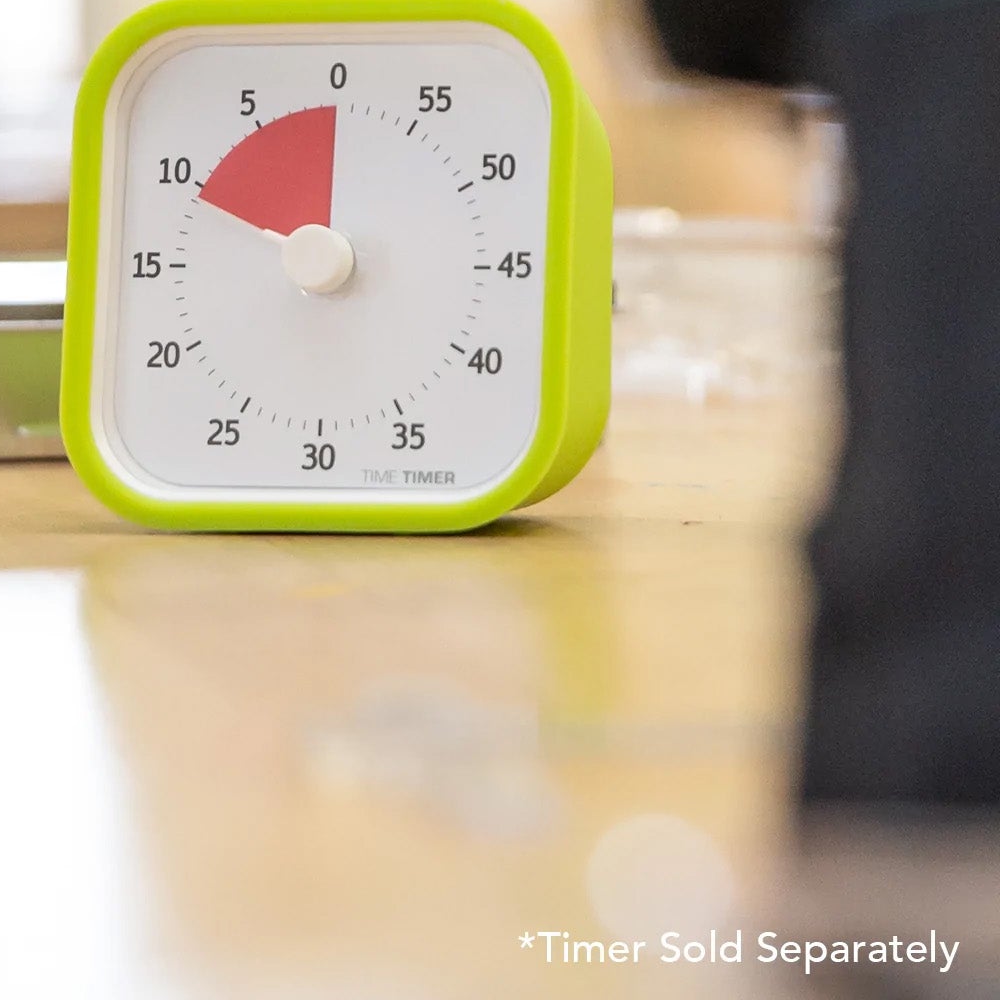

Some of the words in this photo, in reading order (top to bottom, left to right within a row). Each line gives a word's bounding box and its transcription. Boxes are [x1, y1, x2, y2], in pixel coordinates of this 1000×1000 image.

[330, 63, 347, 89] 0
[240, 90, 256, 116] 5
[419, 86, 451, 112] 55
[159, 157, 191, 184] 10
[482, 153, 515, 180] 50
[133, 252, 161, 278] 15
[497, 252, 531, 278] 45
[147, 341, 180, 368] 20
[468, 347, 502, 374] 40
[207, 419, 239, 446] 25
[392, 423, 425, 449] 35
[302, 444, 335, 470] 30
[362, 470, 397, 484] TIME
[403, 471, 455, 484] TIMER
